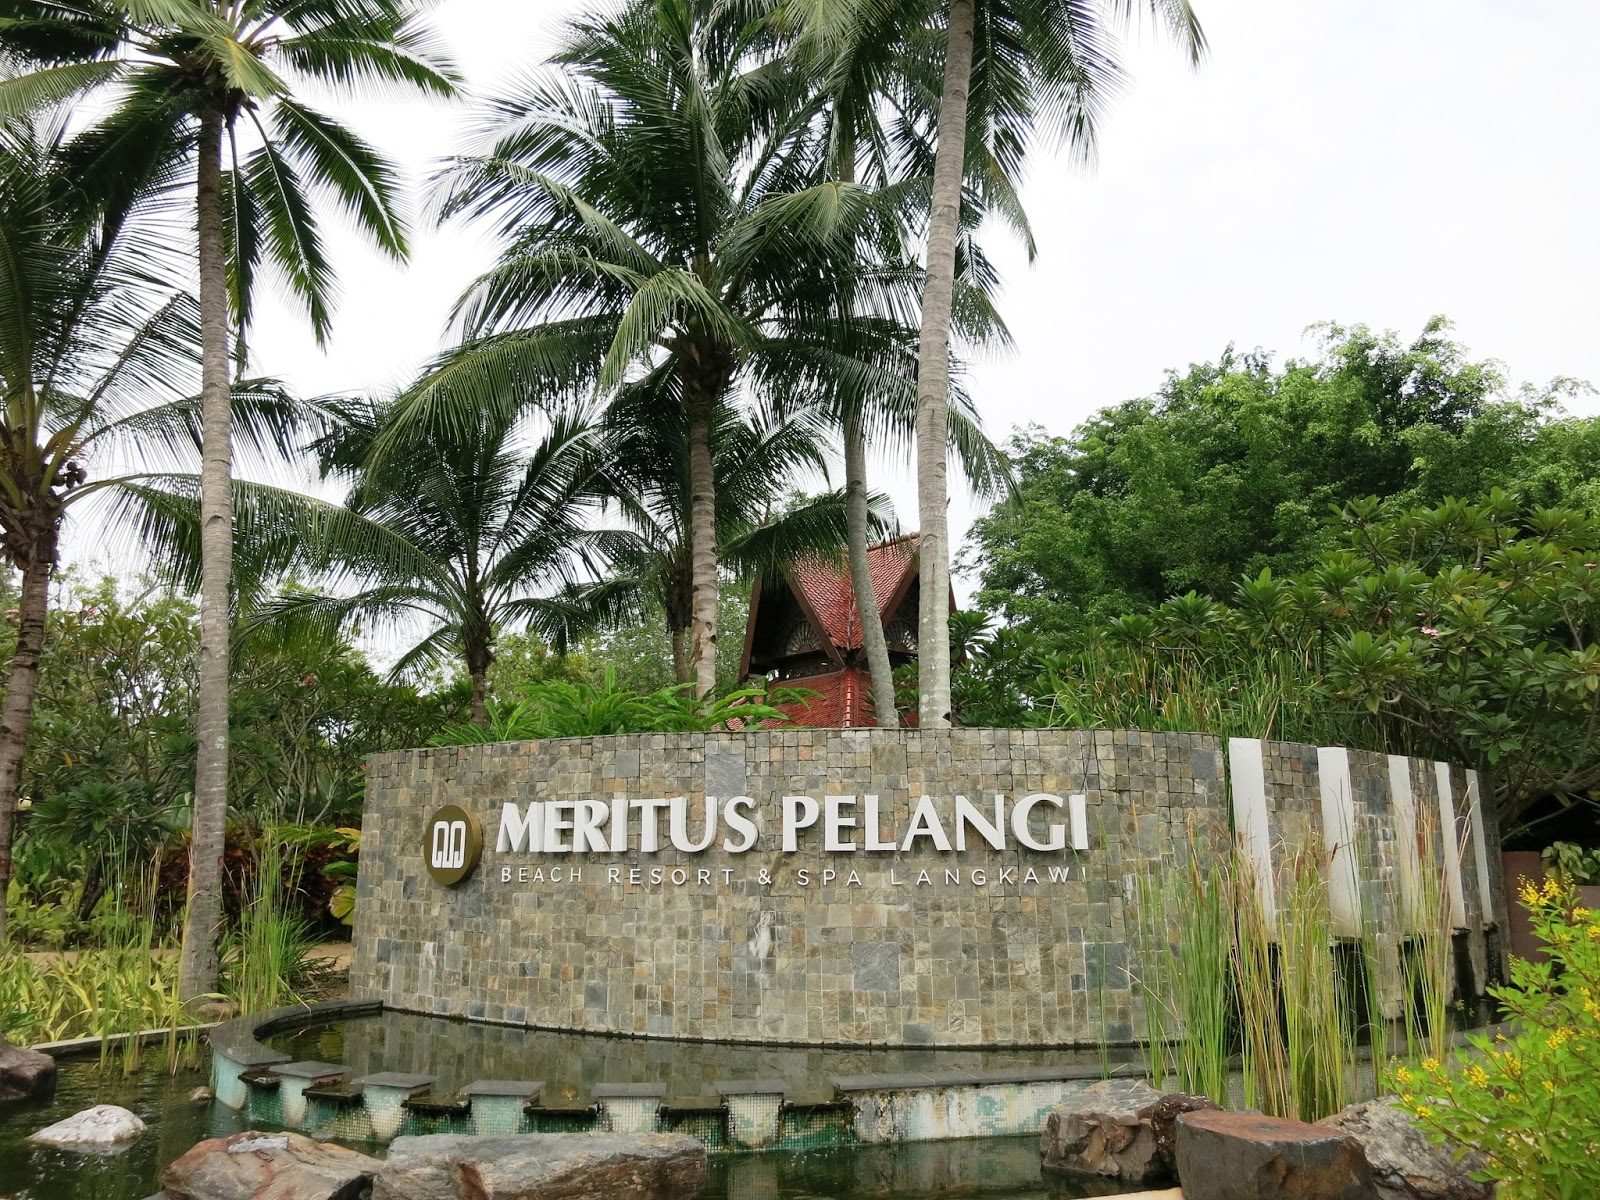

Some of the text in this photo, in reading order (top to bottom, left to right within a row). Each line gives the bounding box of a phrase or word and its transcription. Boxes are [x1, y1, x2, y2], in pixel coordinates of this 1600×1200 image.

[496, 794, 1088, 853] MERITUS PELANGI
[501, 866, 1087, 886] BEACH RESORT & SPA LANGKAWI
